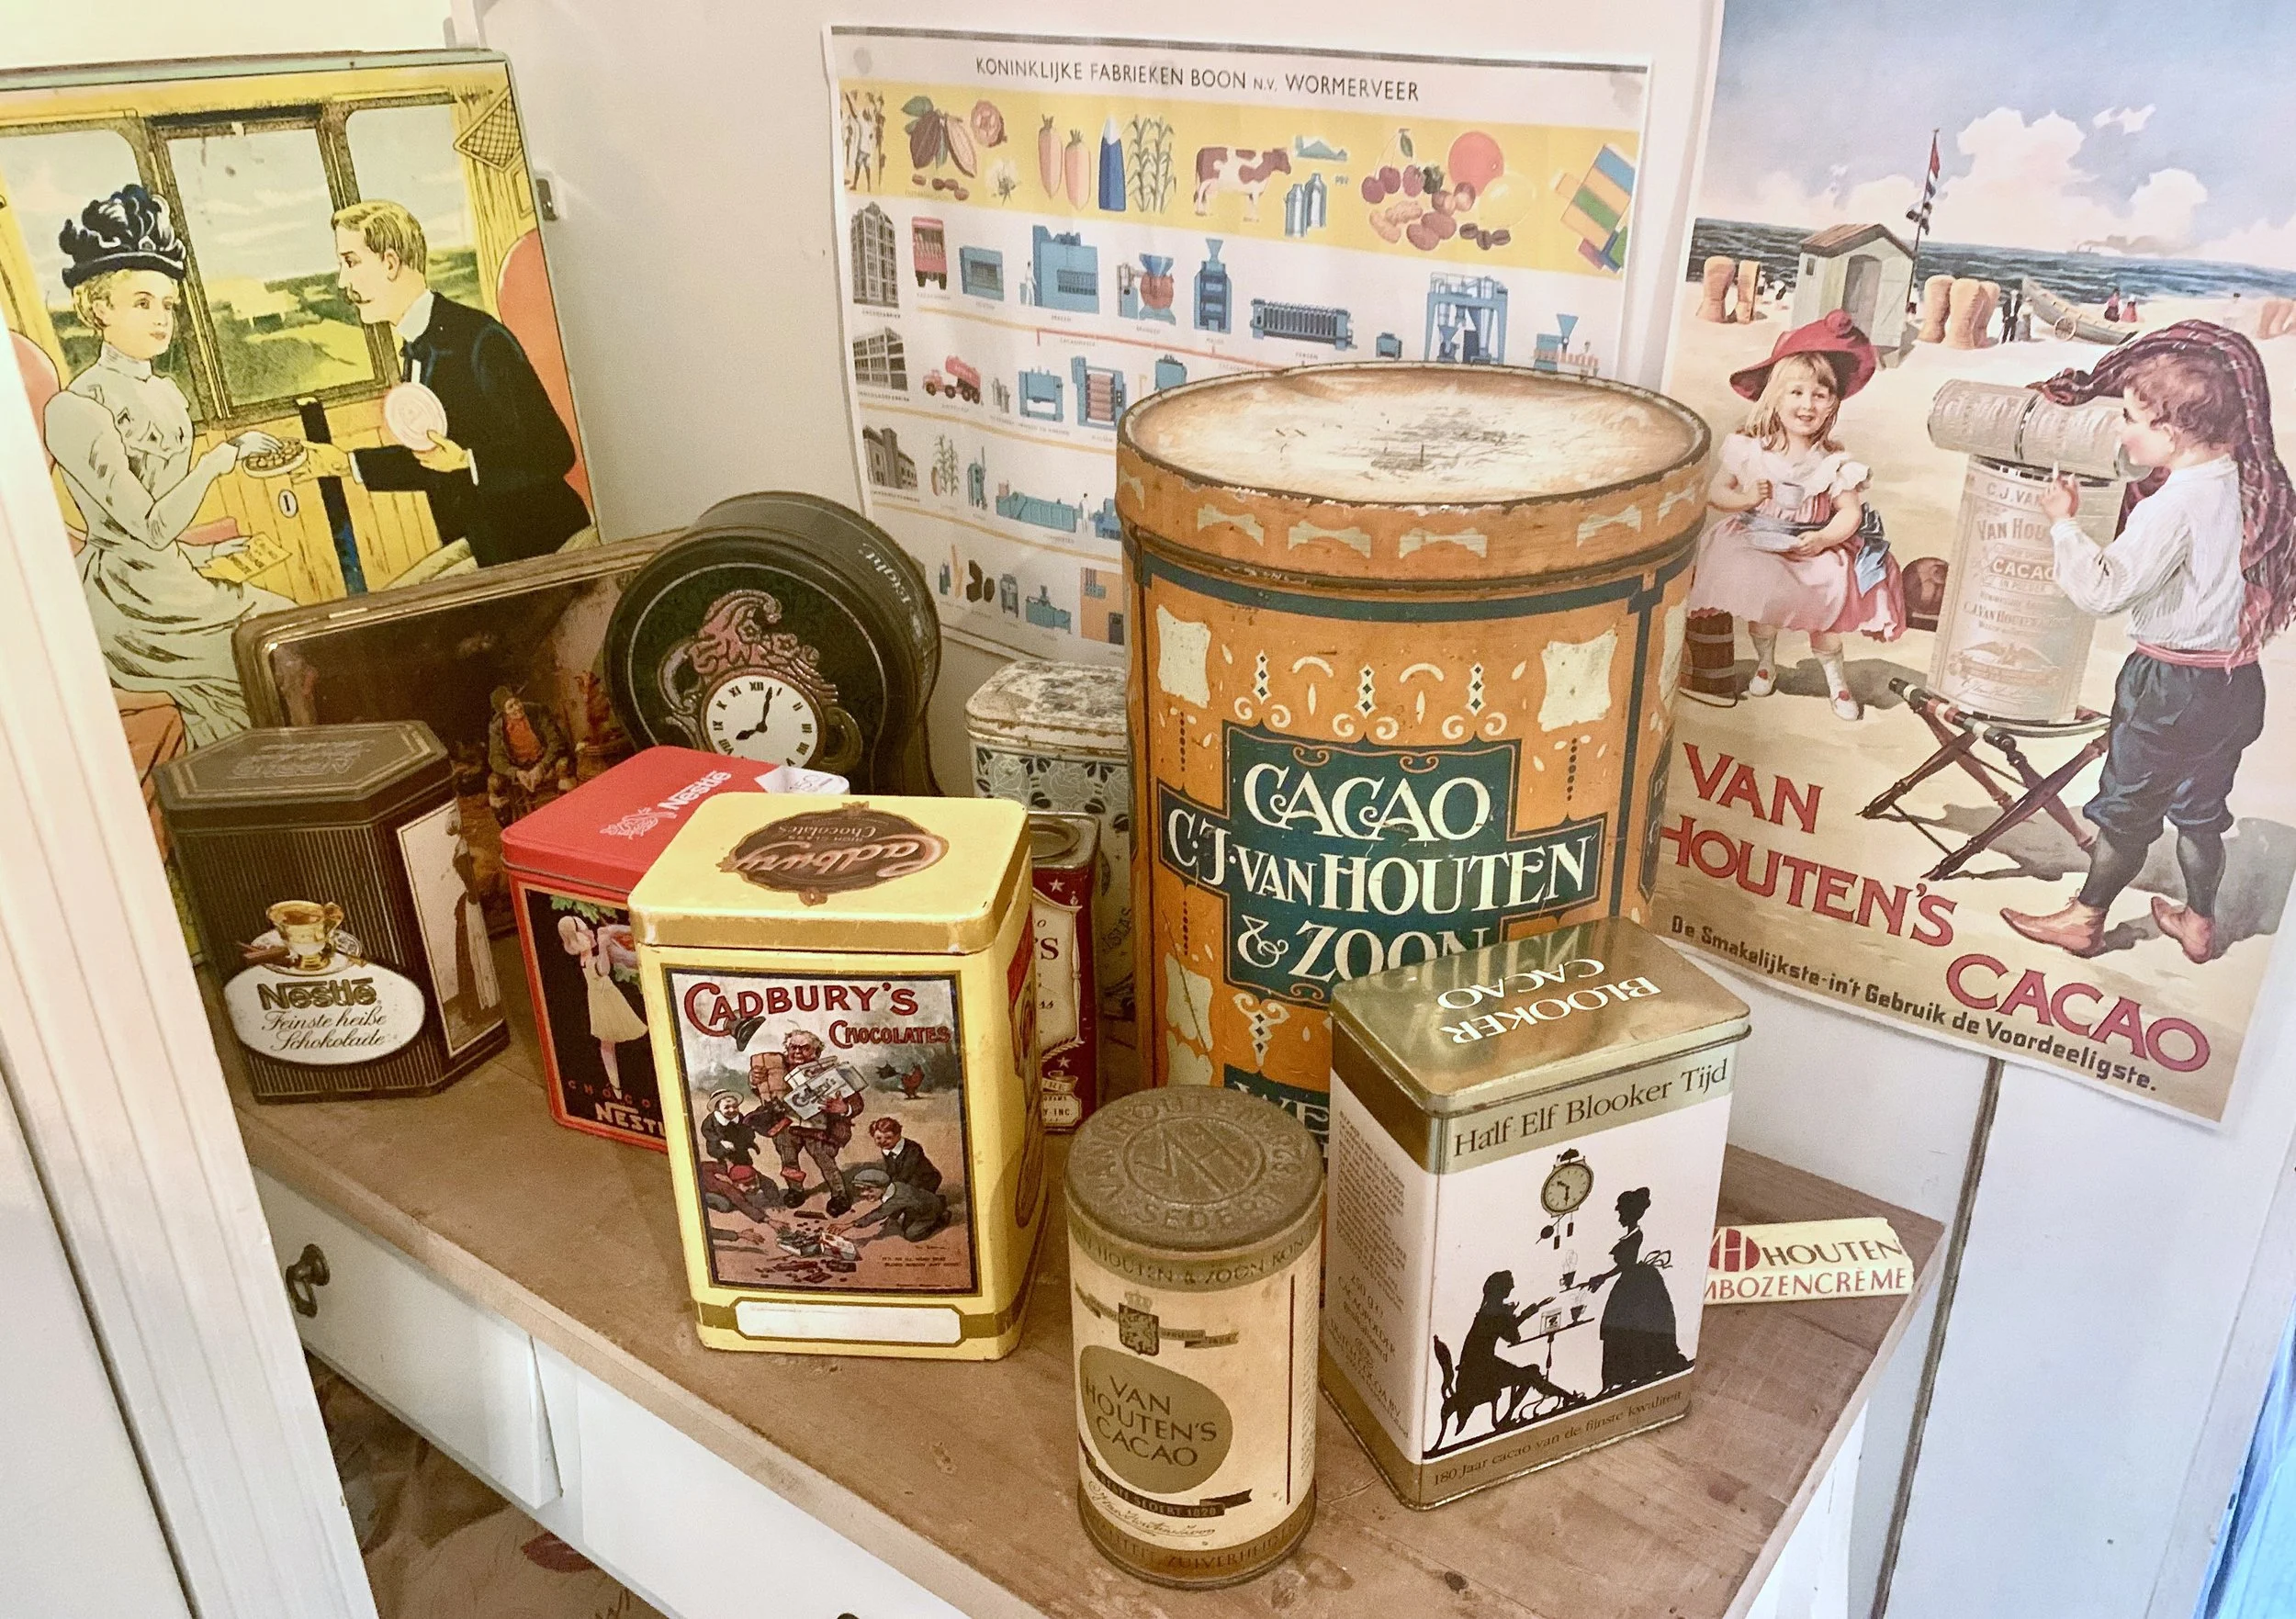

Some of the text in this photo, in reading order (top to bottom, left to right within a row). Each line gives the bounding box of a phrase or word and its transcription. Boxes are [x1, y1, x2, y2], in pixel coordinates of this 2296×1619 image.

[975, 58, 1083, 82] KONINKLIJKE
[1090, 63, 1183, 86] FABRIEKEN
[1191, 69, 1246, 89] BOON
[1285, 73, 1420, 102] WORMERVEER
[1243, 762, 1491, 843] CACAO
[1683, 742, 1823, 834] VAN
[732, 833, 941, 878] Cadbury
[779, 825, 876, 840] Chocolates
[1318, 831, 1593, 916] HOUTEN
[1237, 914, 1289, 969] &
[257, 977, 377, 1010] Nestlé
[683, 981, 919, 1038] CADBURY'S
[1436, 958, 1605, 1011] CACAO
[1439, 975, 1662, 1045] BLOOKER
[1671, 915, 1696, 939] De
[1865, 984, 1945, 1027] Gebruik
[1952, 1011, 1980, 1035] de
[1986, 1020, 2156, 1092] Voordeeligste.
[262, 1006, 388, 1031] Feinste heiße
[270, 1029, 387, 1051] Schokolade
[828, 1020, 951, 1050] CHOCOLATES
[1945, 954, 2211, 1073] CACAO
[1453, 1058, 1728, 1157] Half Elf Blooker Tijd
[1761, 1239, 1904, 1266] HOUTEN
[1086, 1377, 1217, 1442] HOUTEN'S
[1109, 1375, 1171, 1415] VAN
[1097, 1416, 1199, 1467] CACAO
[1434, 1468, 1458, 1487] 180
[1491, 1444, 1532, 1465] cacao
[1536, 1433, 1560, 1449] van
[1565, 1425, 1582, 1439] de
[1585, 1411, 1625, 1435] fijnste
[1626, 1389, 1683, 1418] kwaliteit
